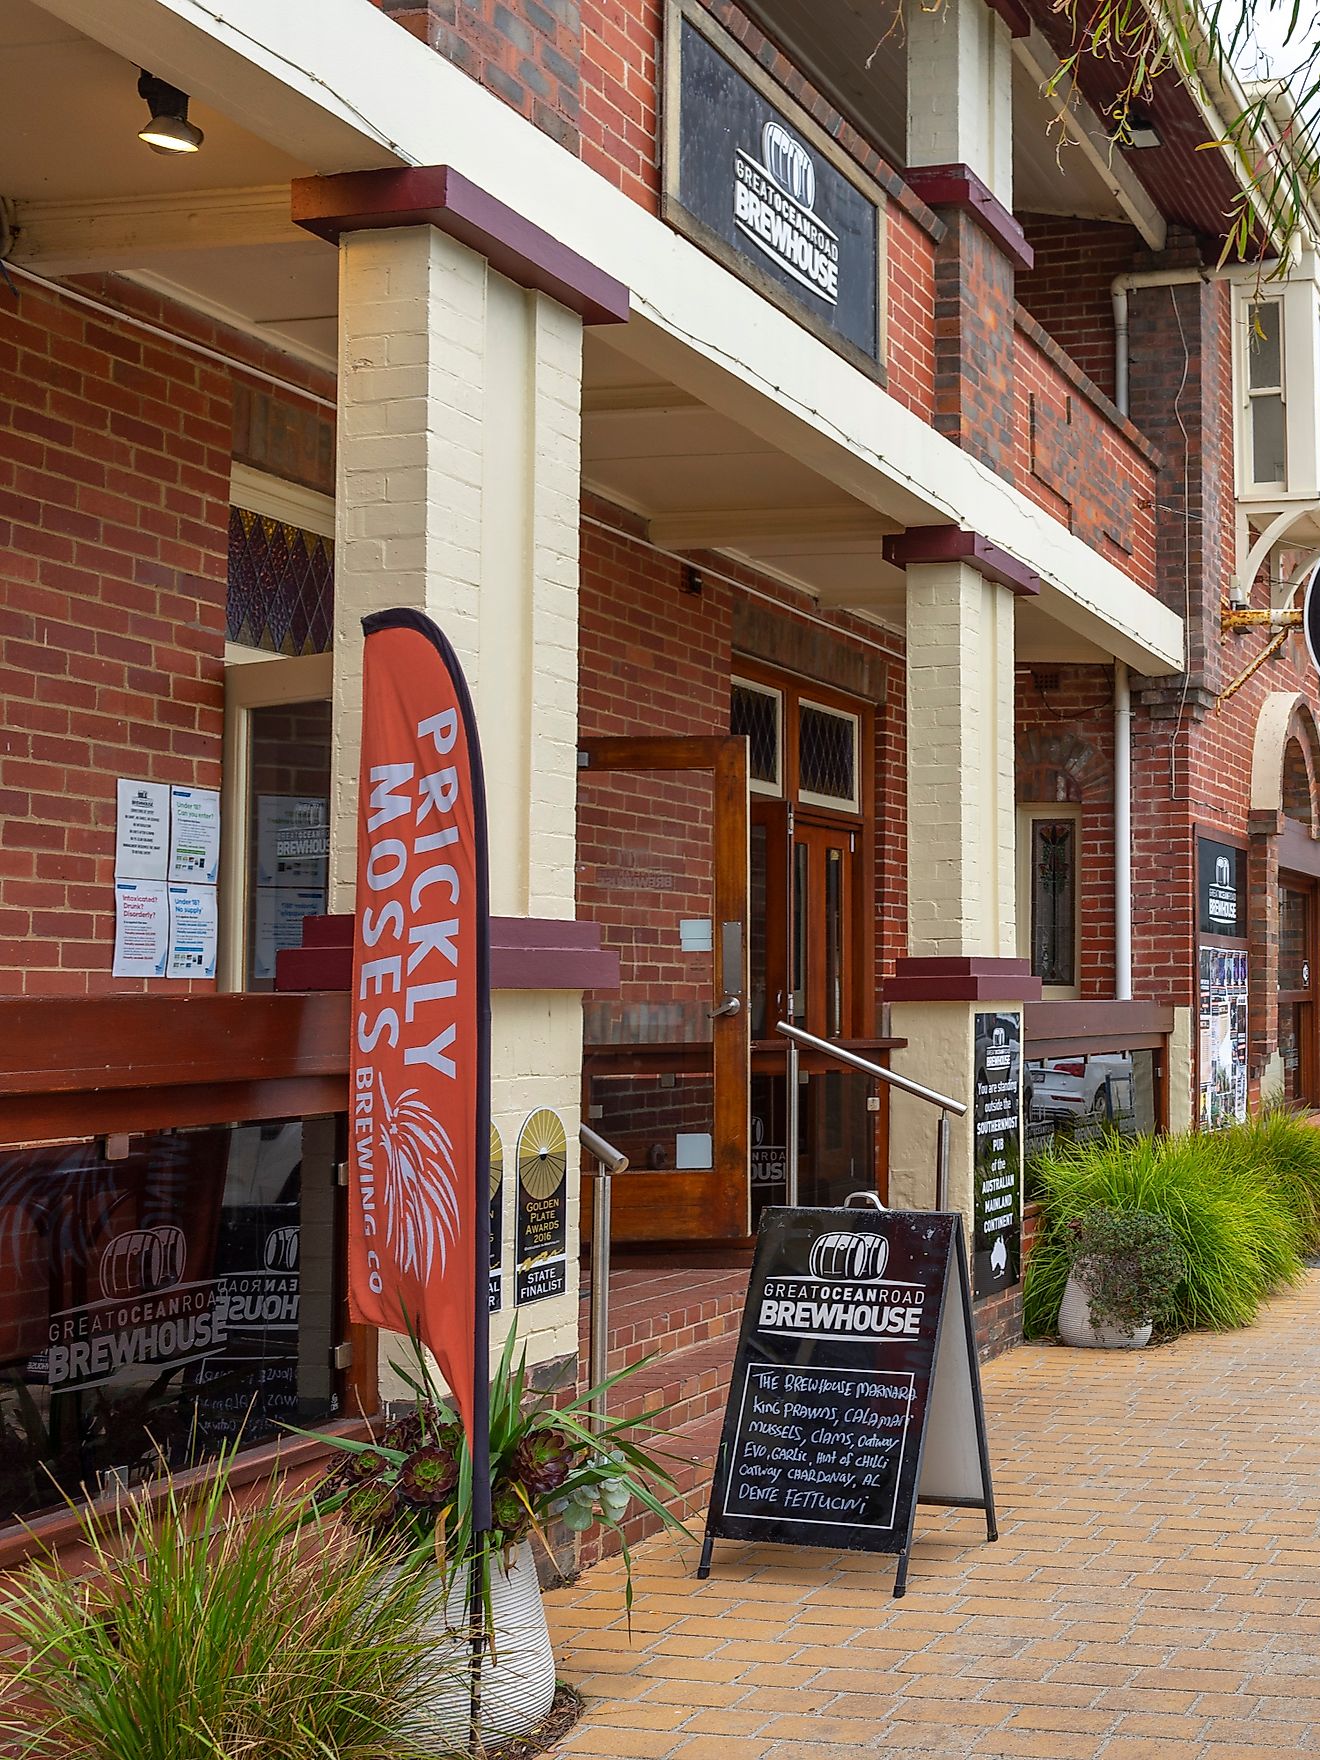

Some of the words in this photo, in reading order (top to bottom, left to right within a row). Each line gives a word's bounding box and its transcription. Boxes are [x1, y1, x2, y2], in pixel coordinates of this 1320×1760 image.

[735, 180, 838, 298] BREWHOUSE
[403, 707, 460, 1080] PRICKLY
[123, 911, 156, 919] Disorderly?
[357, 762, 415, 1053] MOSES
[978, 1083, 988, 1095] You
[988, 1084, 997, 1093] are
[998, 1078, 1017, 1094] standing
[985, 1099, 1003, 1112] outside
[1003, 1097, 1012, 1109] the
[977, 1116, 1018, 1135] SOUTHERNMOST
[355, 1066, 377, 1236] BREWING
[993, 1138, 1004, 1152] PUB
[991, 1159, 997, 1172] of
[997, 1158, 1006, 1170] the
[982, 1173, 1015, 1194] AUSTRALIAN
[526, 1199, 560, 1212] GOLDEN
[984, 1191, 1013, 1213] MAINLAND
[530, 1210, 556, 1223] PLATE
[984, 1212, 1013, 1234] CONTINENT
[525, 1220, 560, 1235] AWARDS
[533, 1231, 552, 1243] 2016
[368, 1250, 383, 1294] CO
[528, 1268, 556, 1284] STATE
[521, 1279, 562, 1299] FINALIST
[763, 1283, 925, 1305] GREATOCEANROAD
[49, 1287, 228, 1342] GREATOCEANROAD
[758, 1301, 924, 1335] BREWHOUSE
[48, 1309, 228, 1384] BREWHOUSE
[752, 1371, 780, 1391] THE
[739, 1483, 780, 1502] DENTE
